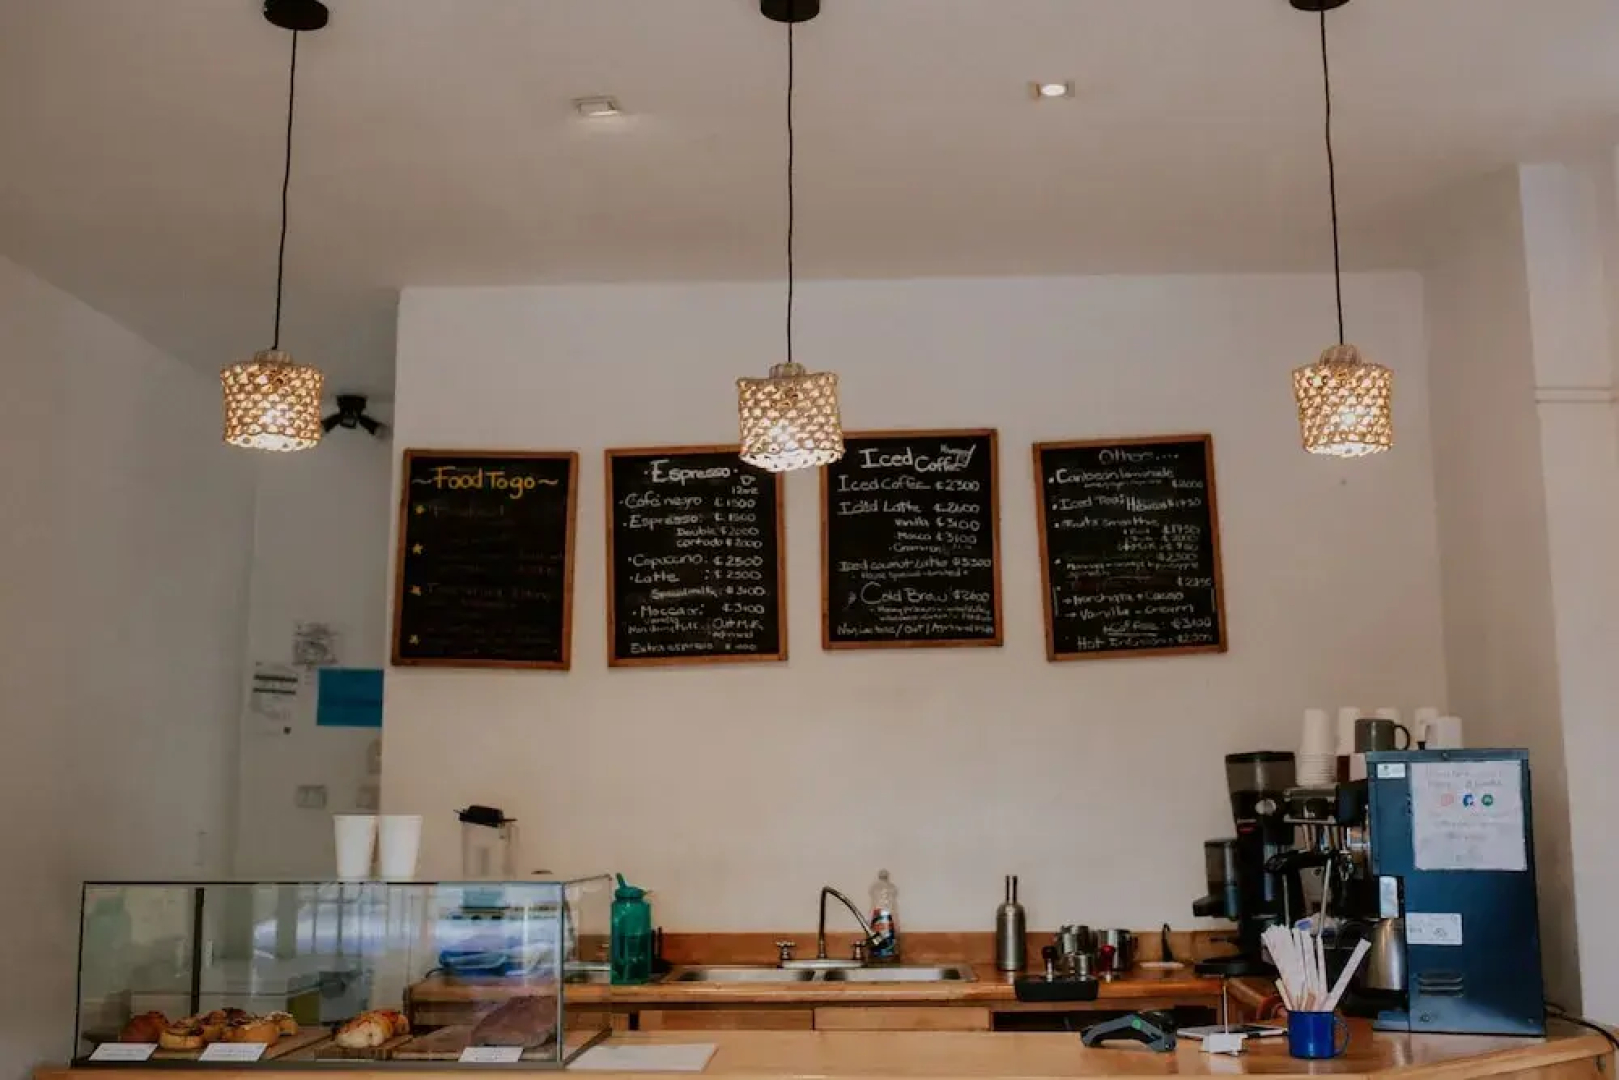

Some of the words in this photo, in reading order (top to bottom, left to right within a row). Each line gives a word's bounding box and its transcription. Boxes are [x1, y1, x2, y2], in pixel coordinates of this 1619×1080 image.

[859, 446, 914, 469] Iced
[432, 466, 484, 490] Food
[485, 470, 507, 490] To
[509, 476, 536, 500] go
[650, 459, 731, 486] Espresso
[837, 474, 880, 492] Iced
[860, 580, 903, 605] Cold
